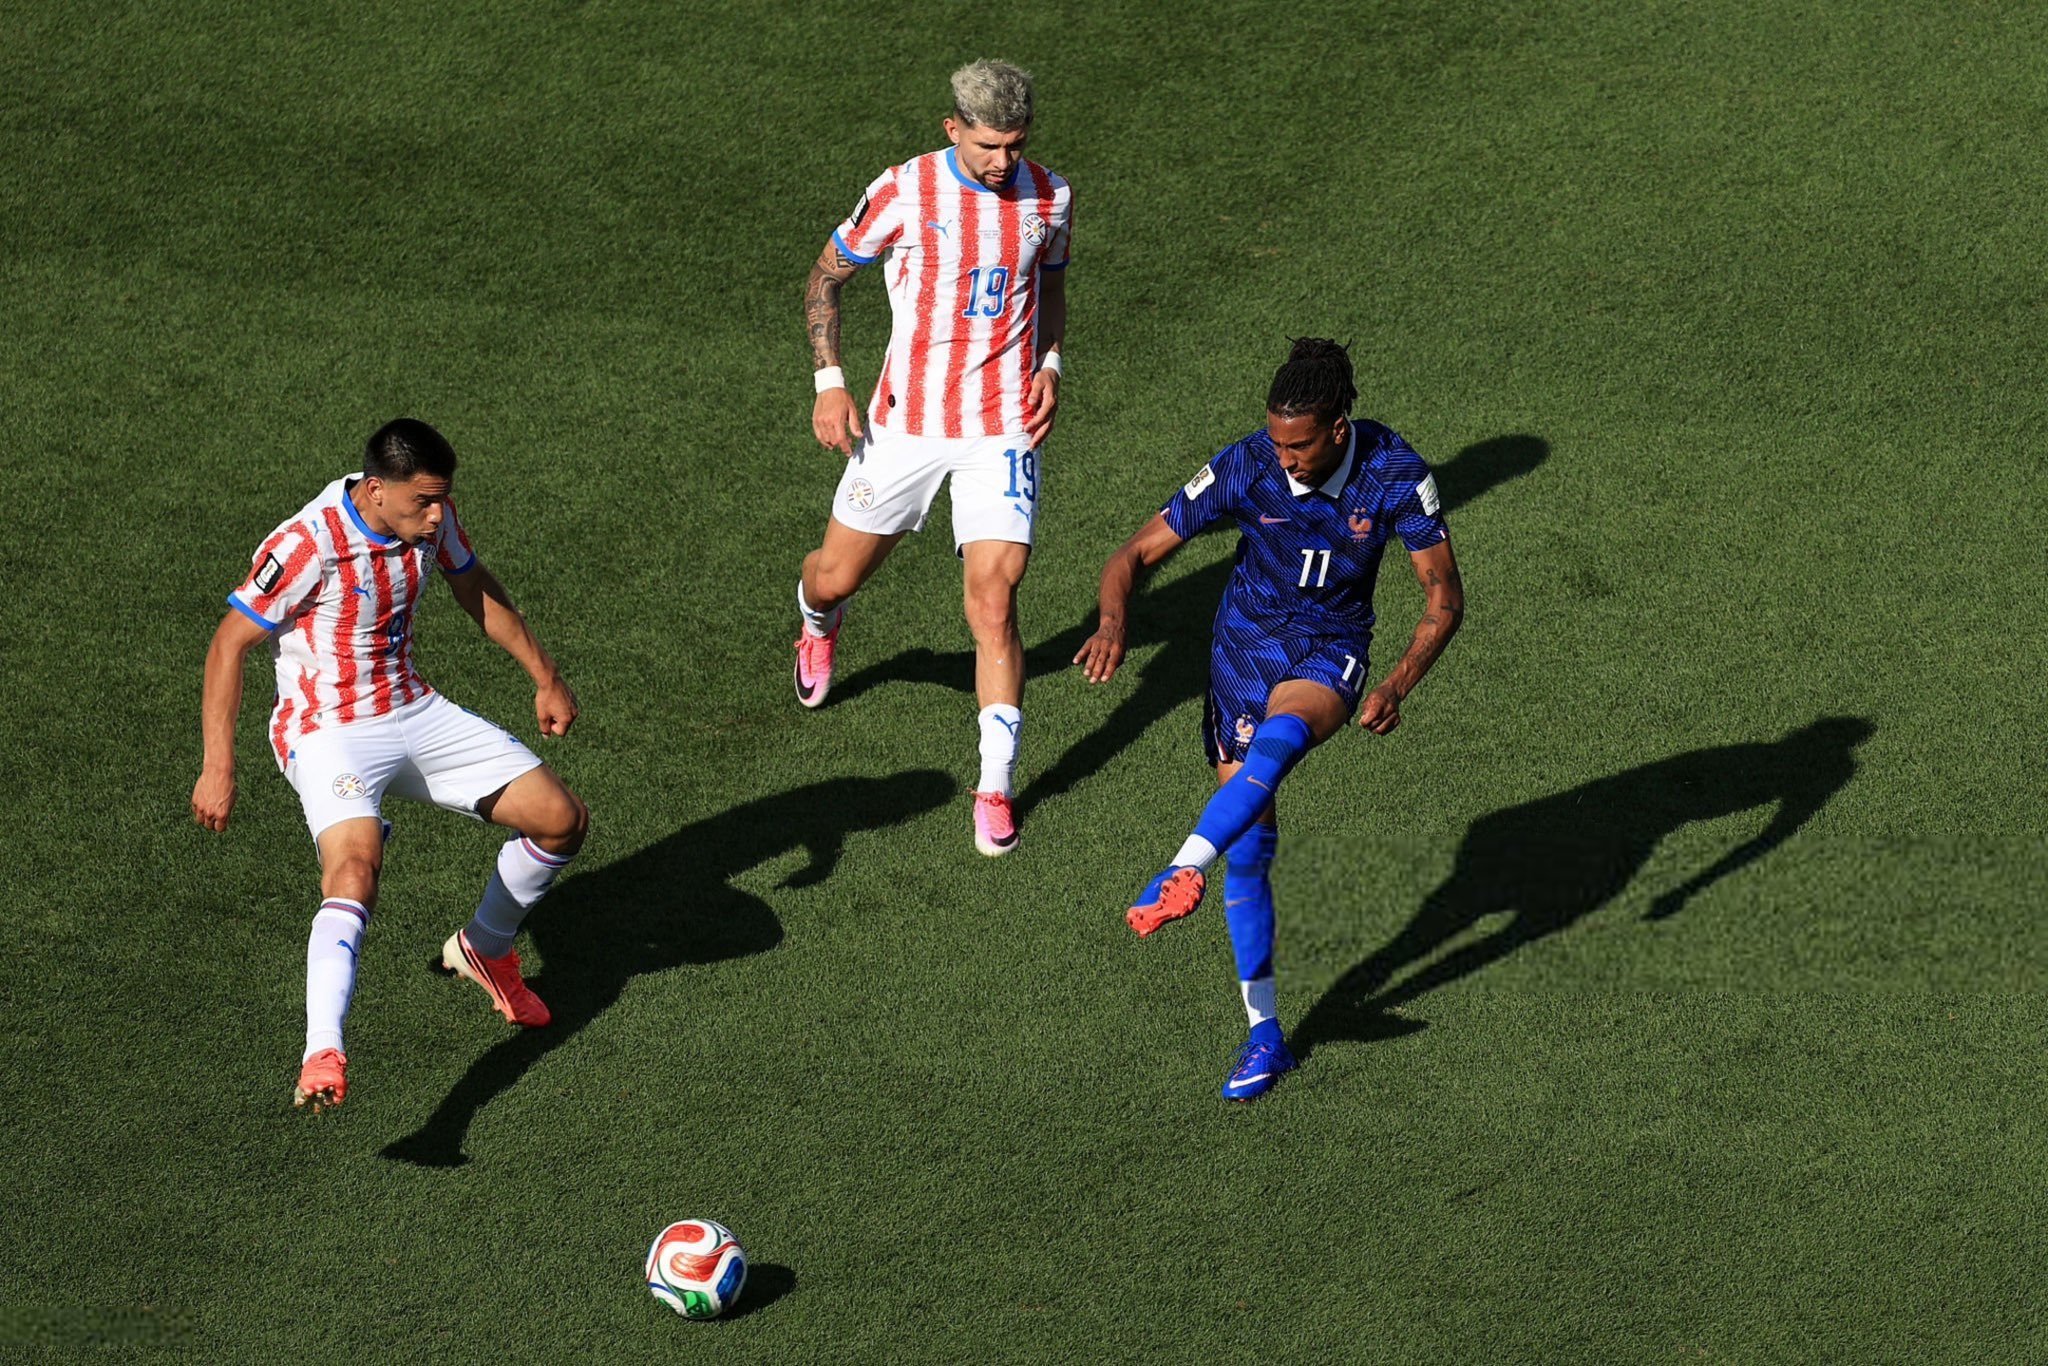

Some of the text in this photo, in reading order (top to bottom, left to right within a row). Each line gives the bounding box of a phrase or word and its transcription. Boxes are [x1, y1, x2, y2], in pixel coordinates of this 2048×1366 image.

[963, 267, 1008, 318] 19
[1003, 449, 1035, 500] 19
[1298, 549, 1331, 588] 11
[1341, 654, 1366, 694] 11
